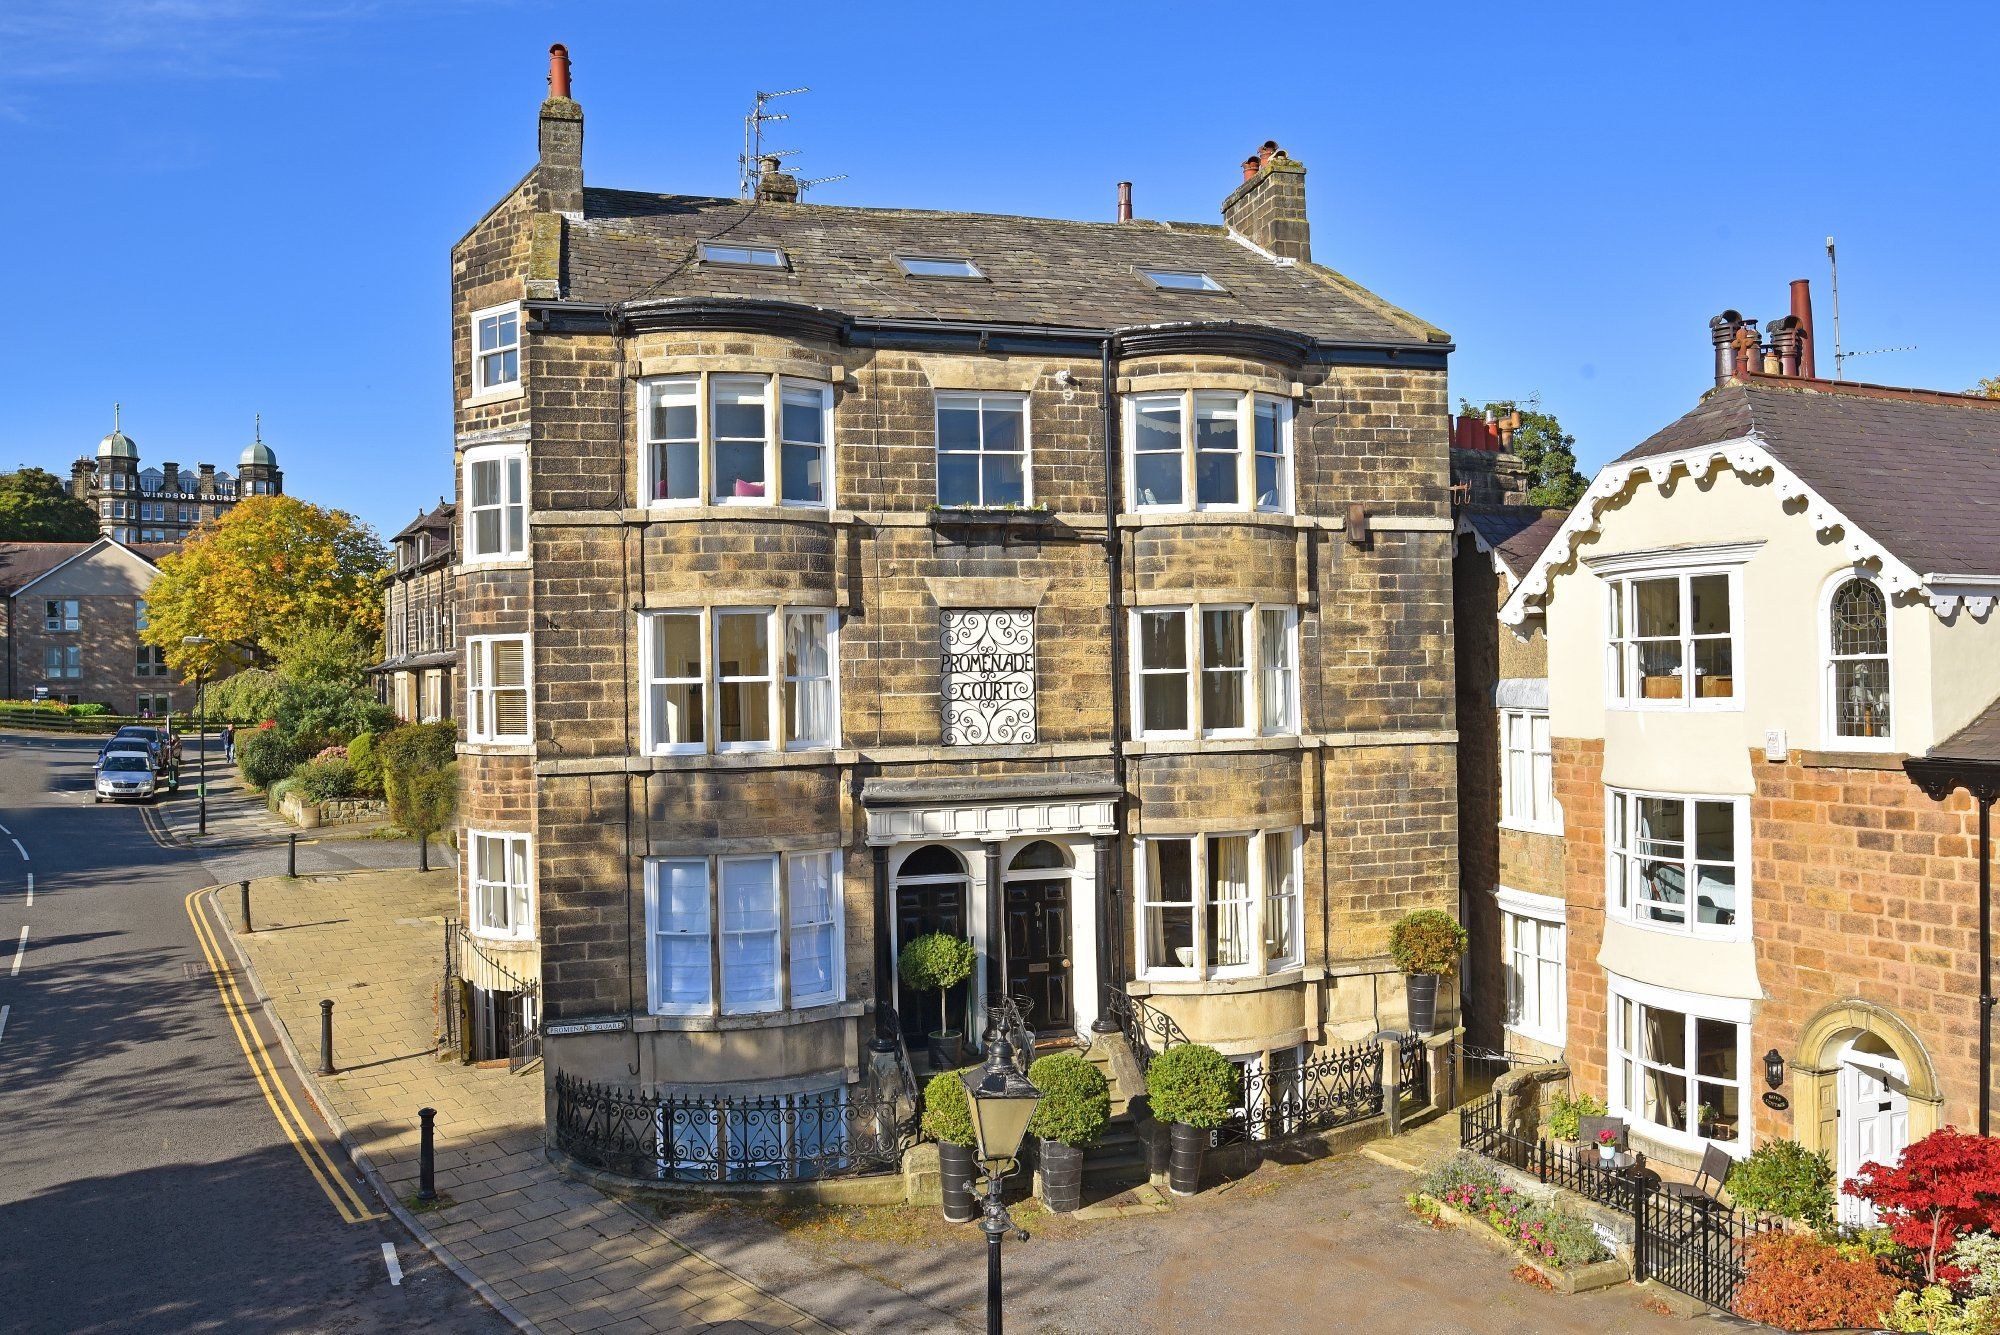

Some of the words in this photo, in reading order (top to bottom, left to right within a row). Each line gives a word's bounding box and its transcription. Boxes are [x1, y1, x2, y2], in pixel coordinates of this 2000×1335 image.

[142, 492, 194, 500] WINDSOR
[201, 493, 236, 501] HOUSE
[941, 654, 1033, 672] PROMENADE
[961, 682, 1012, 700] COURT
[550, 1025, 592, 1034] PROMENADE
[595, 1022, 621, 1031] SQUARE
